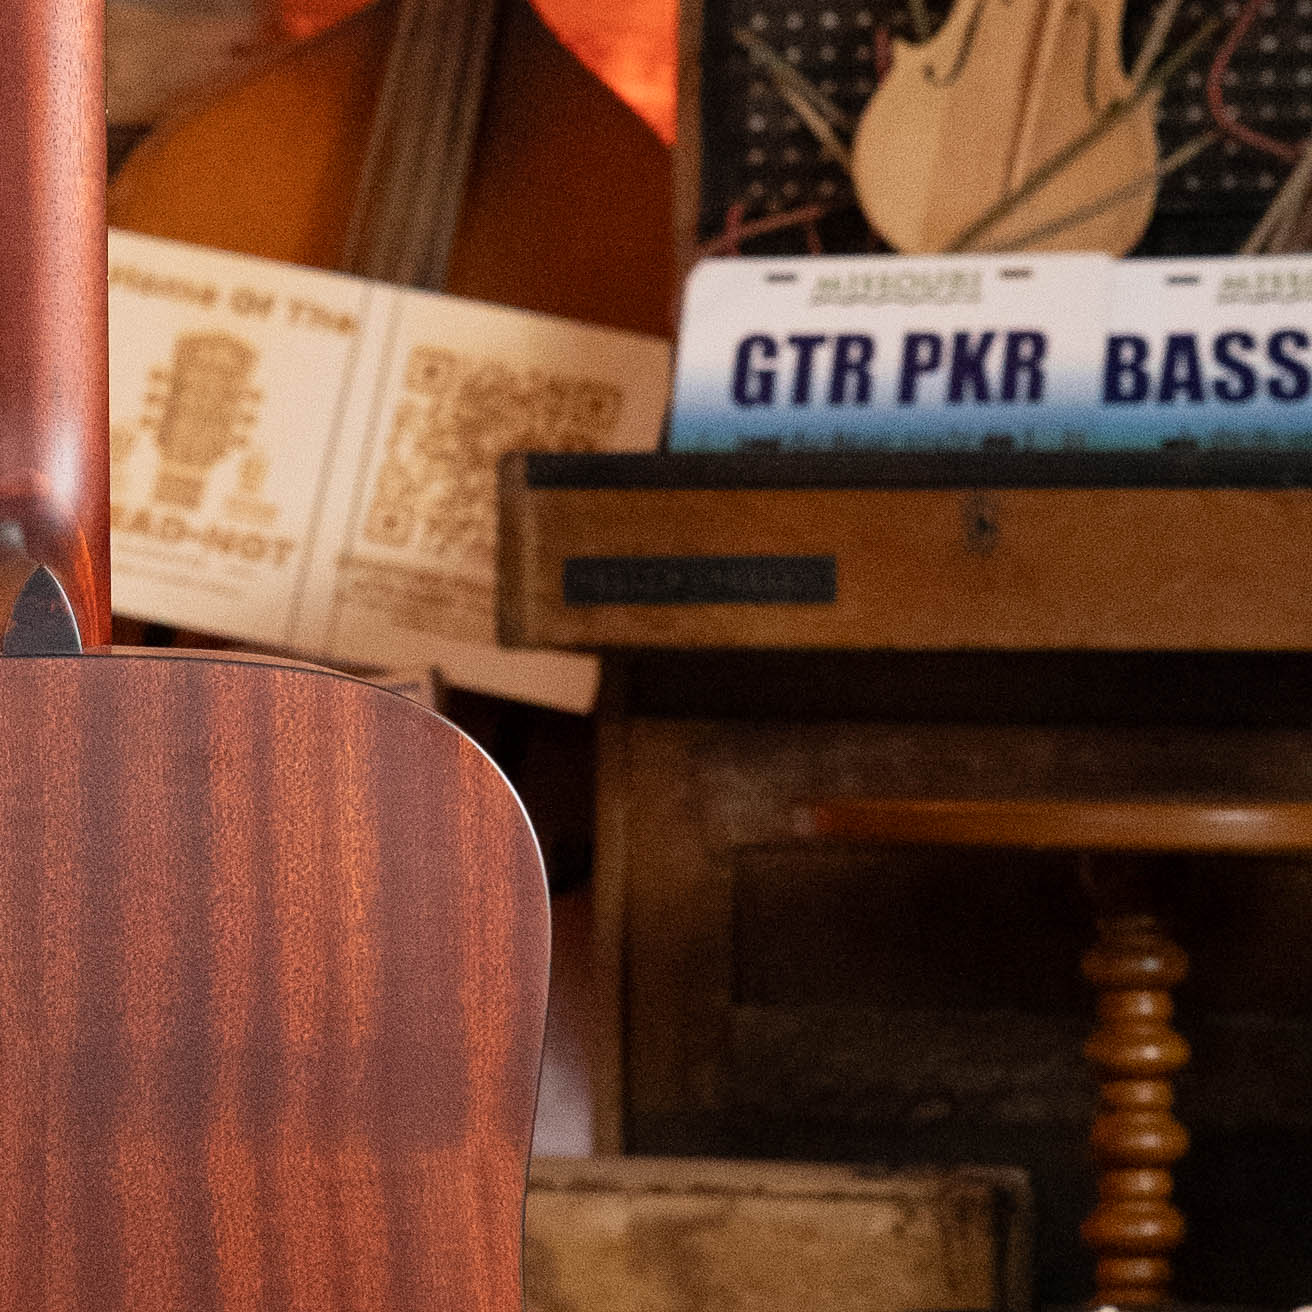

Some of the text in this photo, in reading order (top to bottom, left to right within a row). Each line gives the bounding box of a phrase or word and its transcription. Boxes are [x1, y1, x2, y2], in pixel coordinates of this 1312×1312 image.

[731, 329, 1048, 407] GTR PKR
[1101, 329, 1312, 407] BASS
